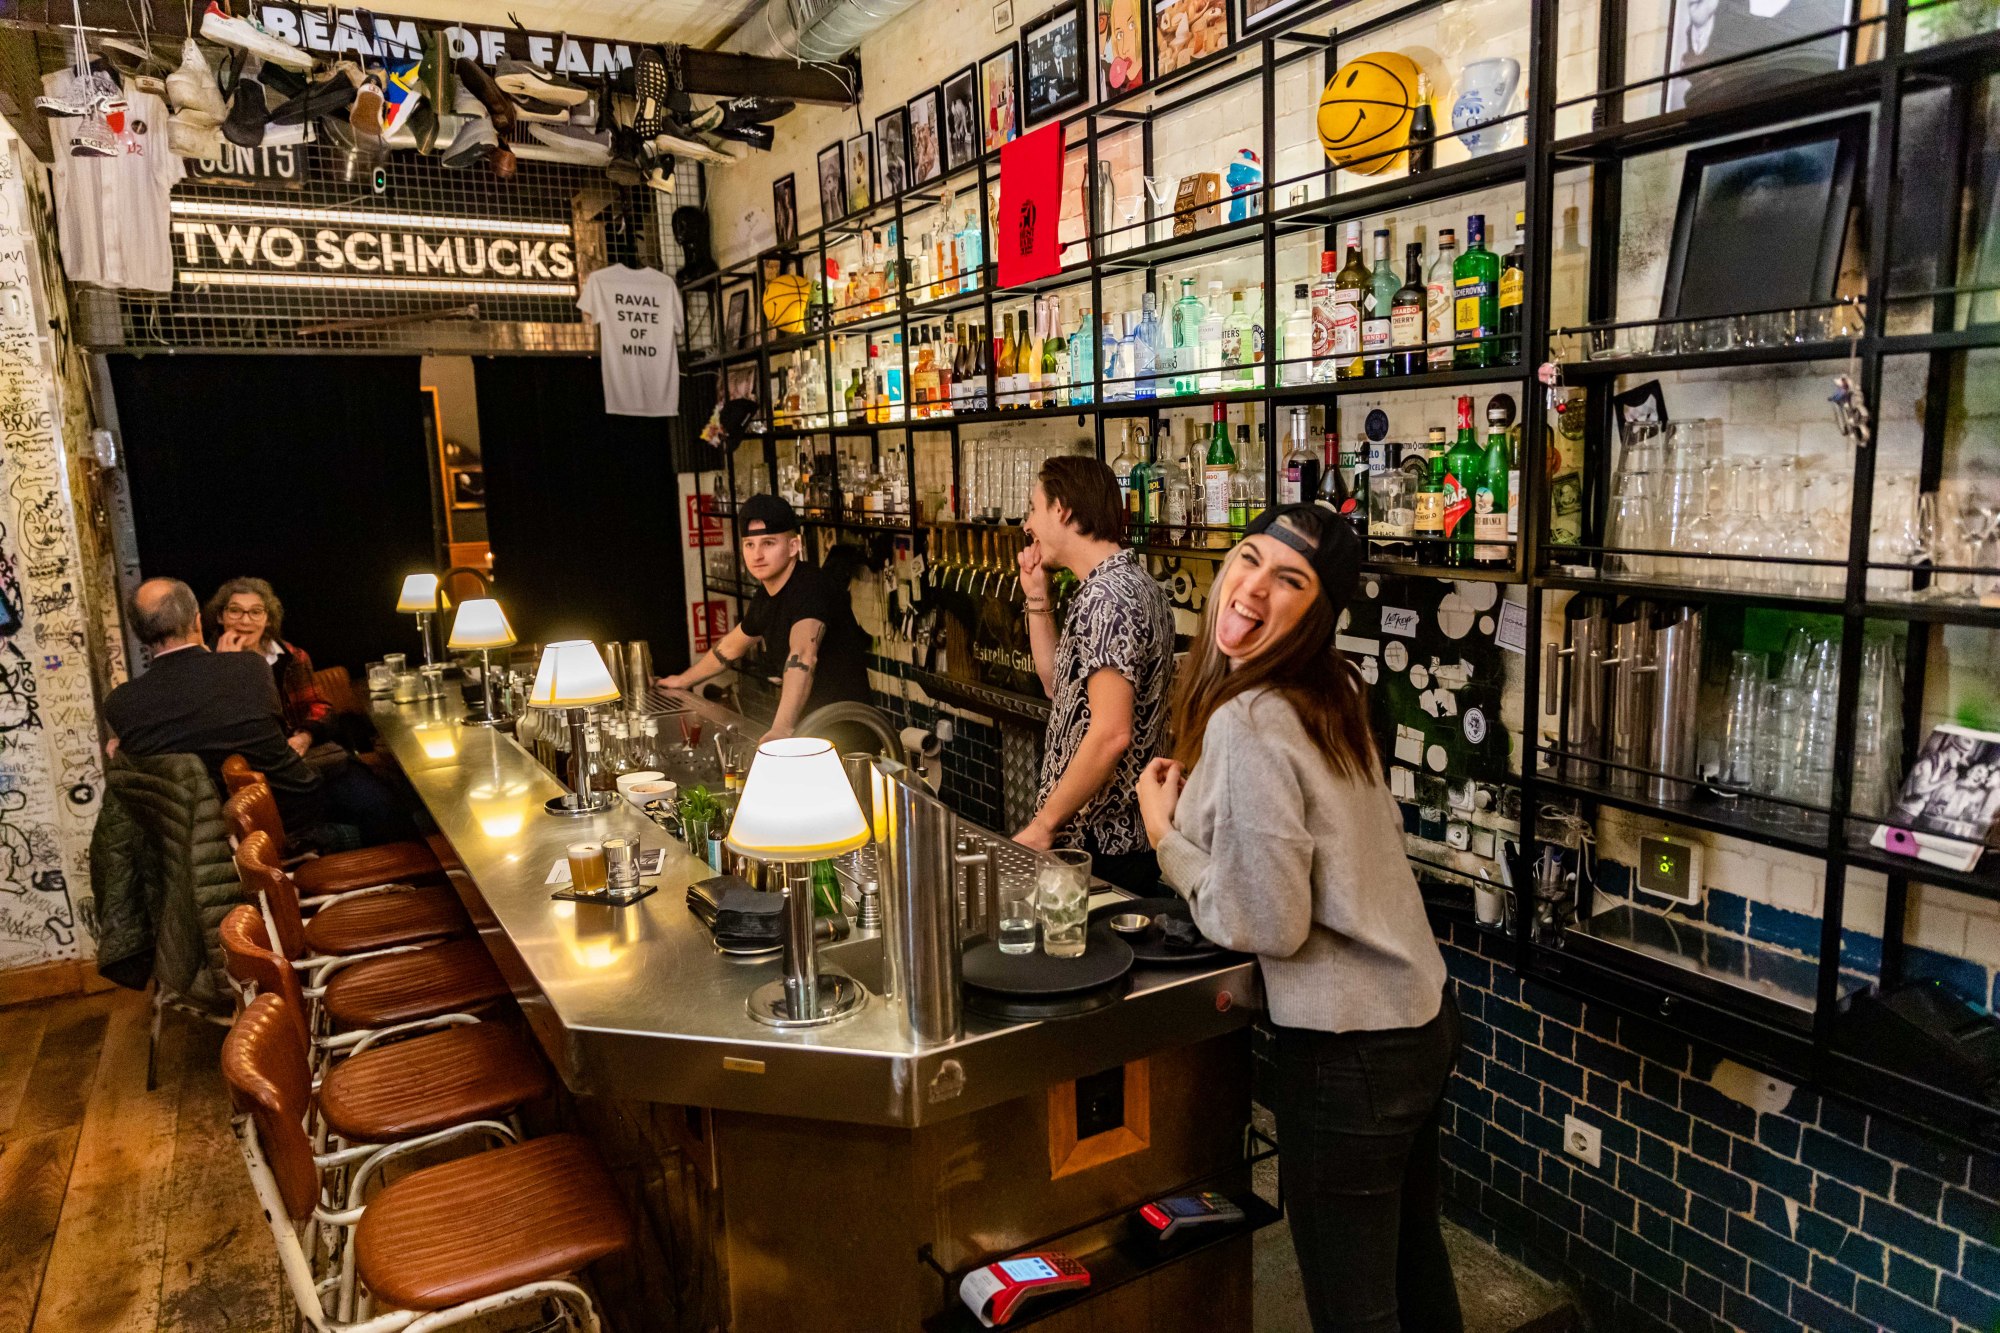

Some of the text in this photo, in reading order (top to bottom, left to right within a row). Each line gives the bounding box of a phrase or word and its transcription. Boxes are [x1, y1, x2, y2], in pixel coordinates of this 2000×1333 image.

[262, 5, 633, 80] BEAM OF FAM
[172, 222, 575, 279] TWO SCHMUCKS
[615, 293, 660, 308] RAVAL
[617, 310, 659, 324] STATE
[630, 328, 648, 340] OF
[622, 344, 657, 357] MIND
[973, 641, 1011, 668] Estrella
